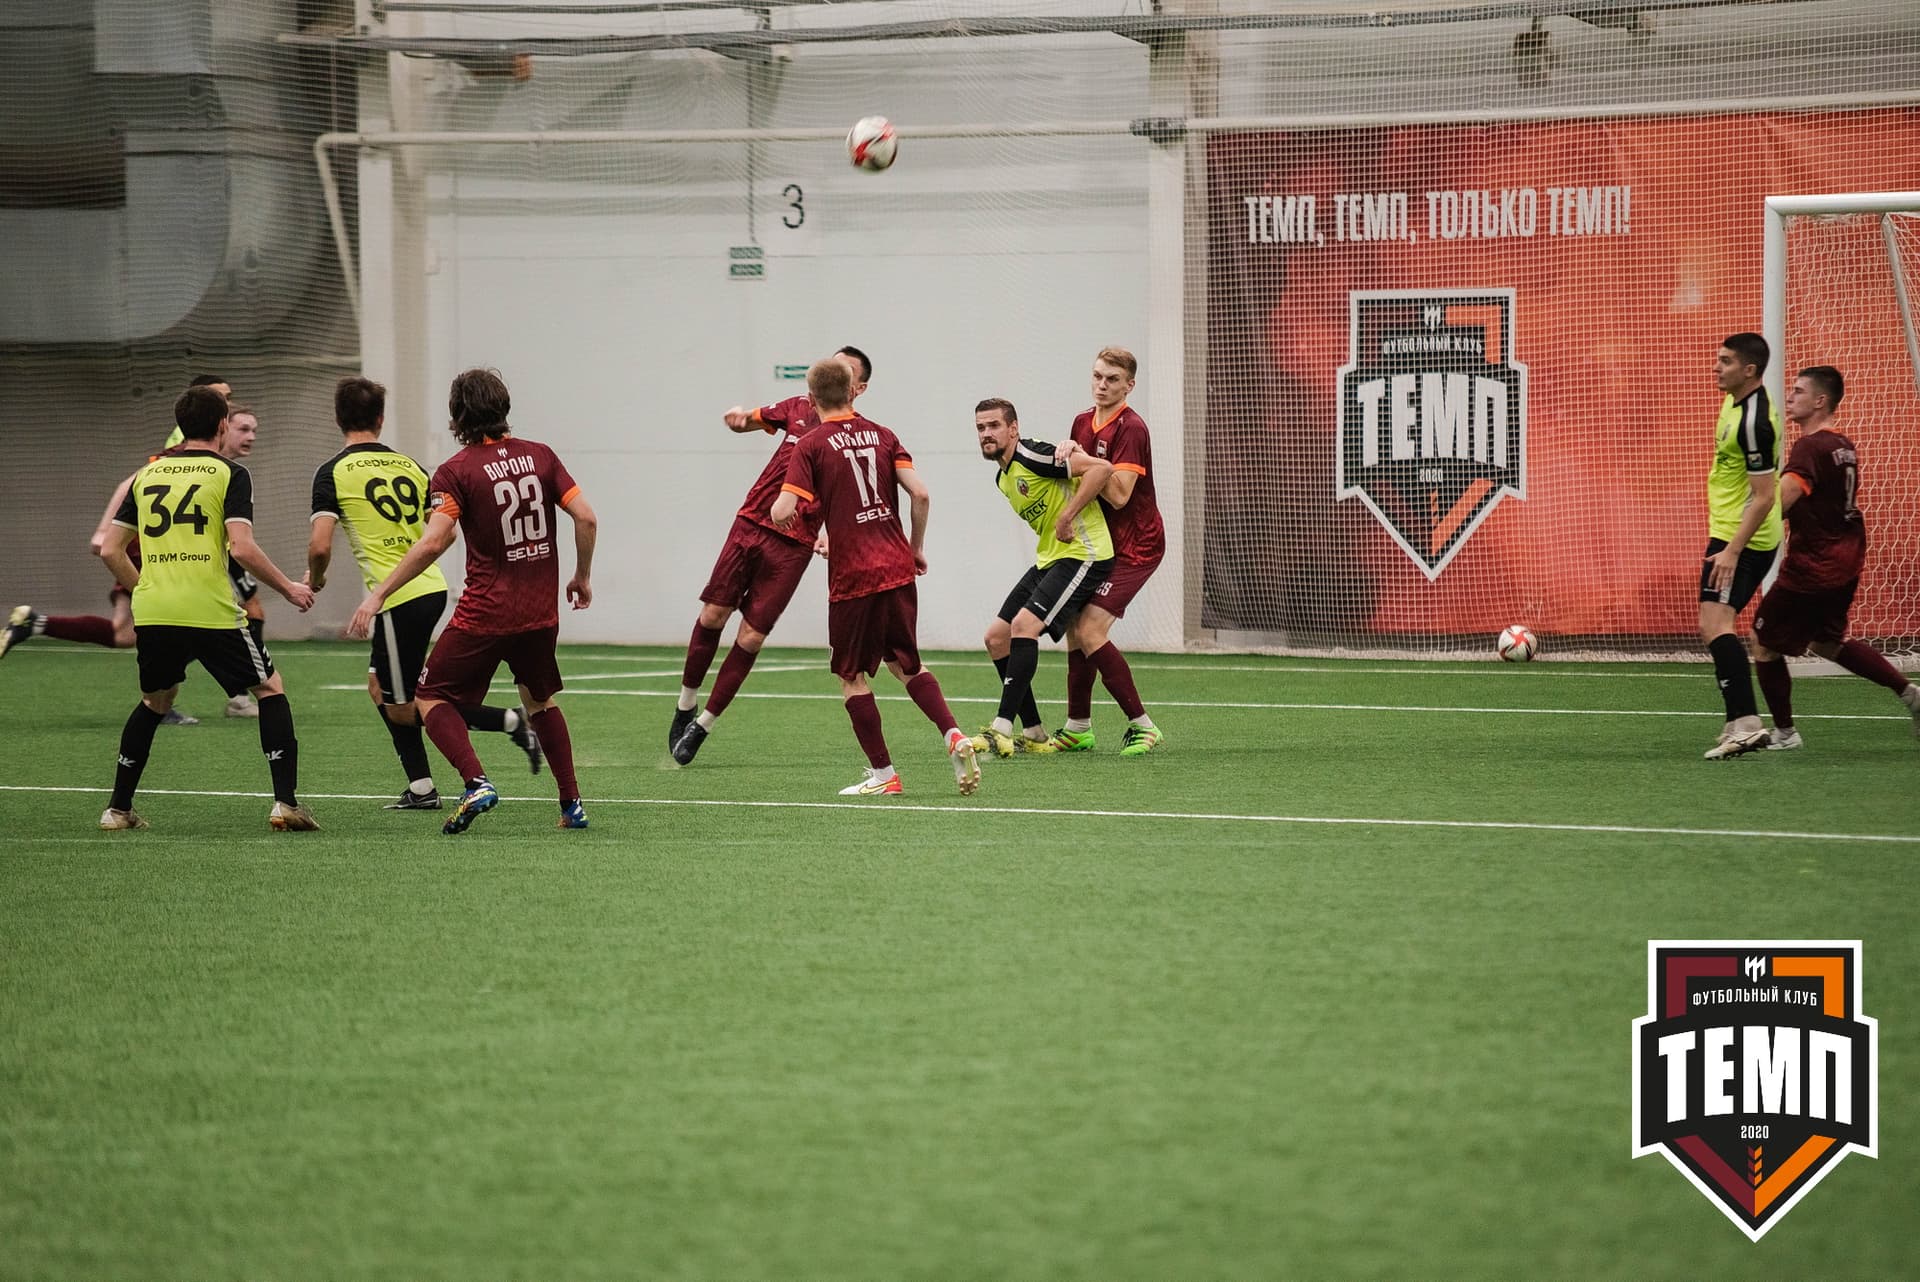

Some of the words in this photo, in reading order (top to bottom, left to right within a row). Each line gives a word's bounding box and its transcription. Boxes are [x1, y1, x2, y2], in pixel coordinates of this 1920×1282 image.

[782, 183, 805, 230] 3
[1244, 195, 1325, 248] ТЕМП,
[1333, 191, 1417, 246] ТЕМП,
[1426, 187, 1537, 240] ТОЛЬКО
[1547, 185, 1631, 236] ТЕМП!
[1357, 372, 1508, 469] ТЕМП
[483, 455, 535, 481] ВОРОНА
[843, 447, 883, 508] 17
[143, 484, 209, 538] 34
[364, 475, 420, 526] 69
[493, 474, 548, 546] 23
[159, 553, 178, 564] RVM
[180, 552, 211, 563] Group
[506, 542, 550, 561] SEUS
